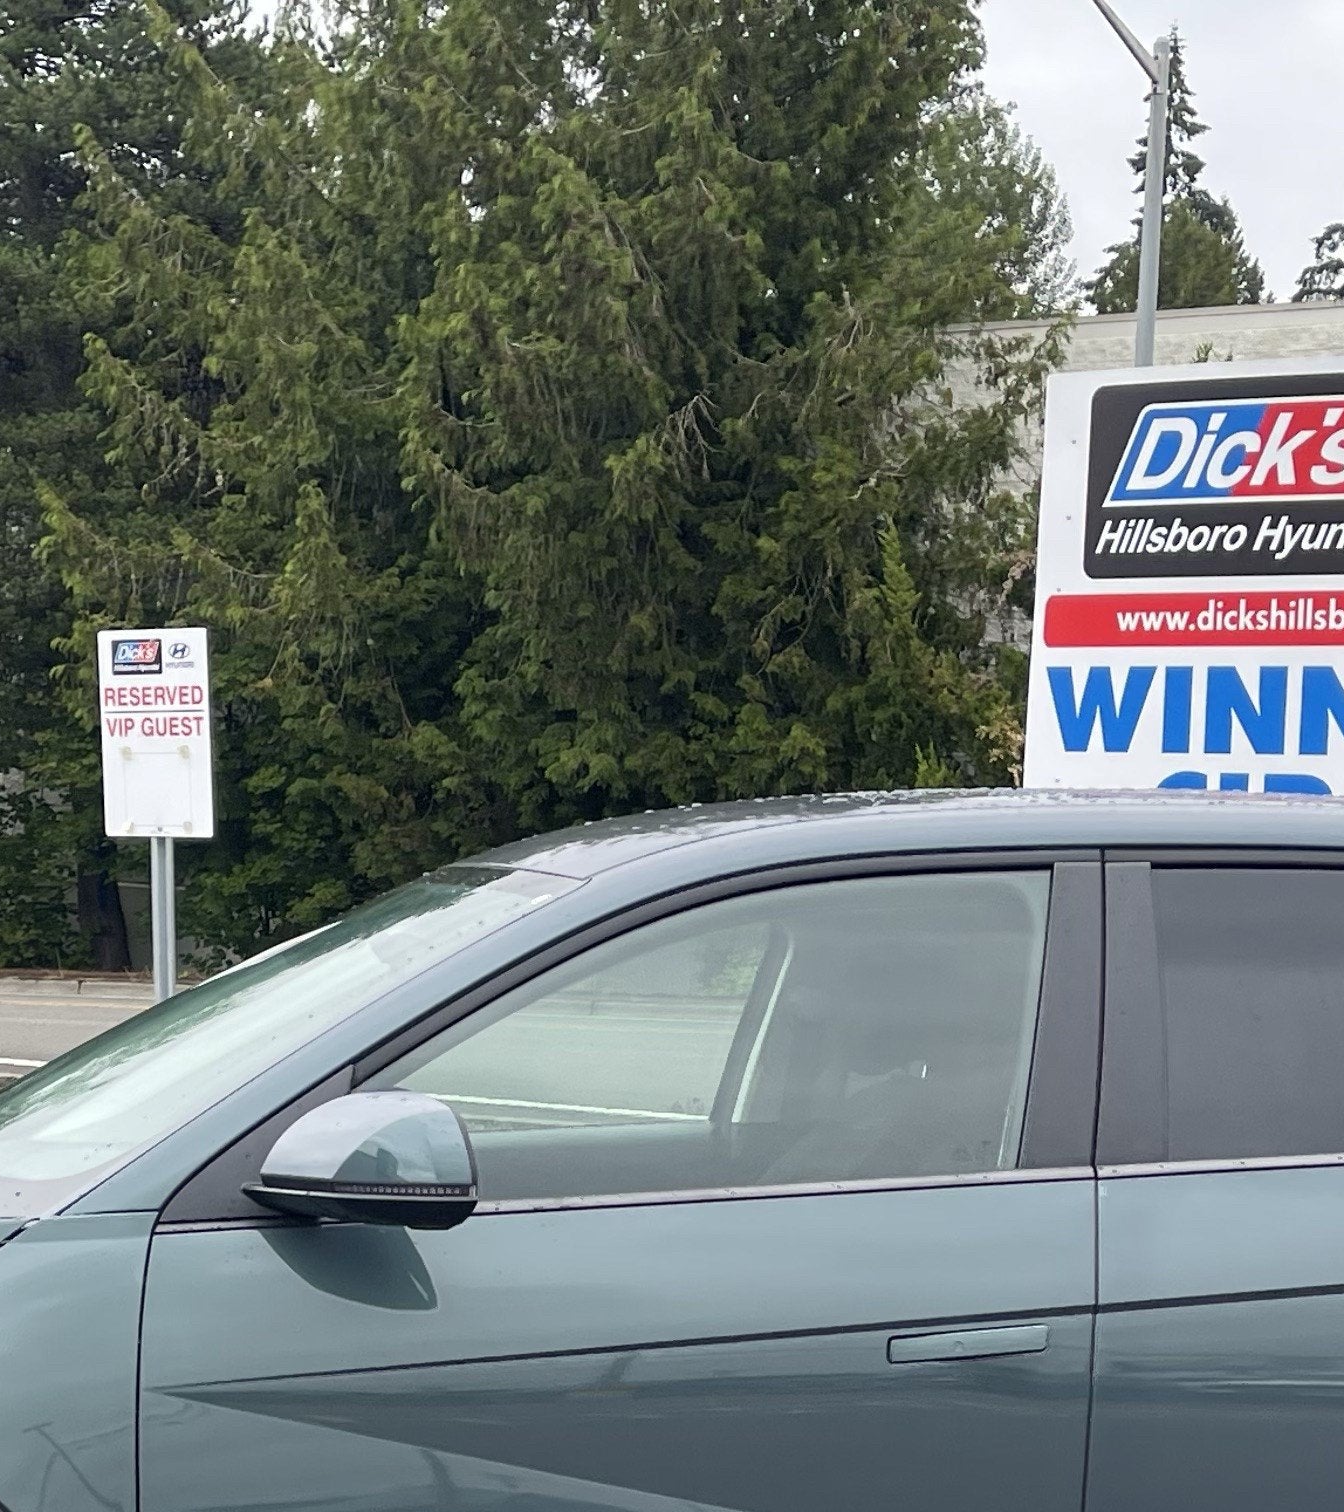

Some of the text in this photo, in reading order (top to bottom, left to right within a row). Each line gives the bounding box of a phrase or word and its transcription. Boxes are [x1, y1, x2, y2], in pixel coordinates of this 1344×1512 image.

[1094, 514, 1248, 555] Hillsboro
[104, 685, 203, 706] RESERVED
[106, 716, 203, 737] VIP GUEST
